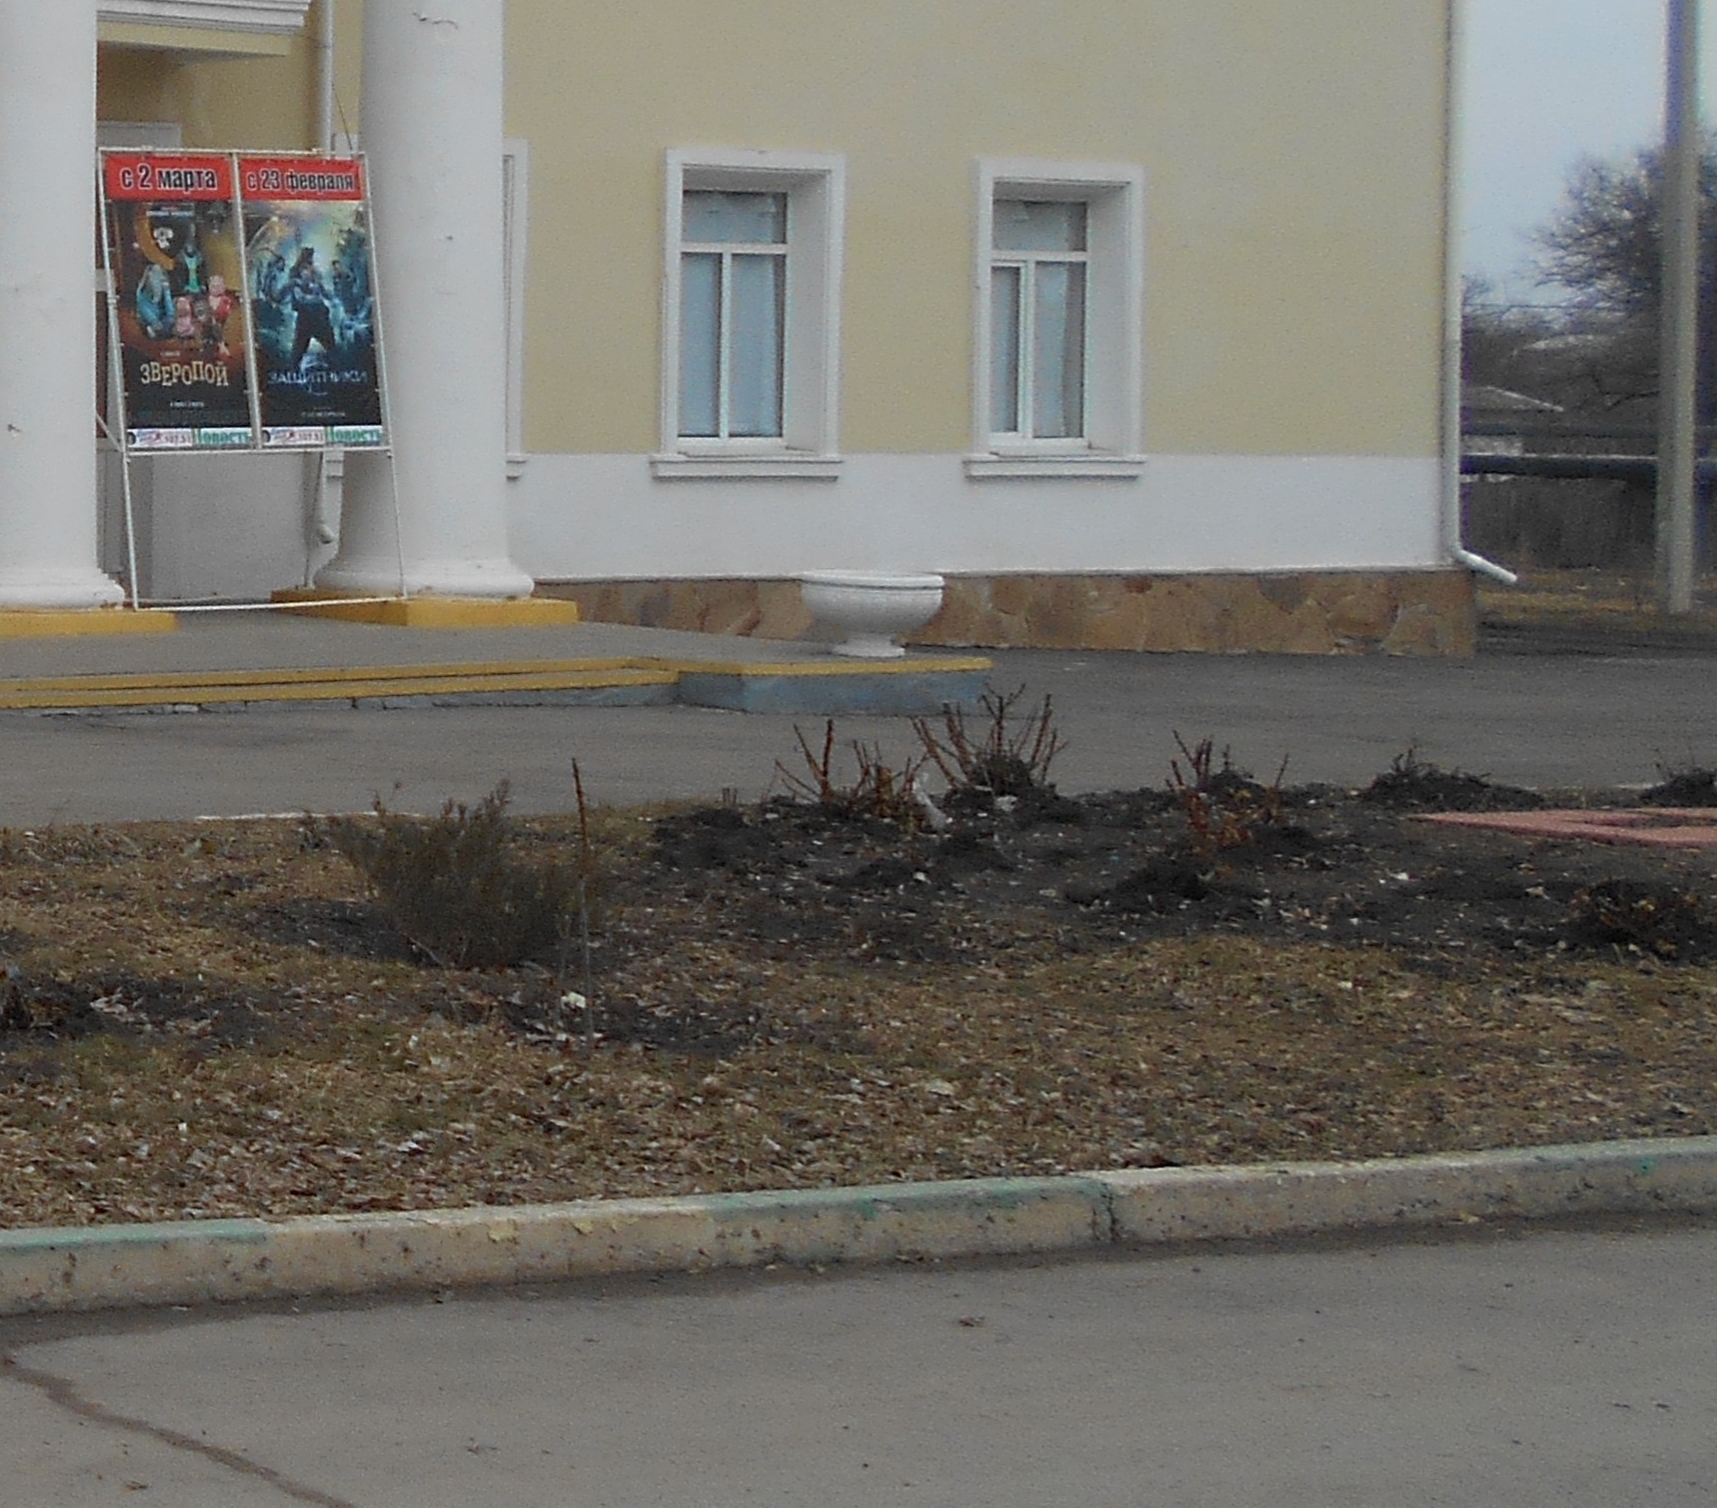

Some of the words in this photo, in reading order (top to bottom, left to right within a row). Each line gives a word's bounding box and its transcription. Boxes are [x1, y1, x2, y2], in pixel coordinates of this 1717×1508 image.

[121, 168, 133, 189] с
[138, 164, 152, 189] 2
[156, 169, 217, 193] марта
[260, 169, 281, 190] 23
[285, 170, 354, 194] февраля
[140, 361, 229, 387] ЗВЕРОПОЙ
